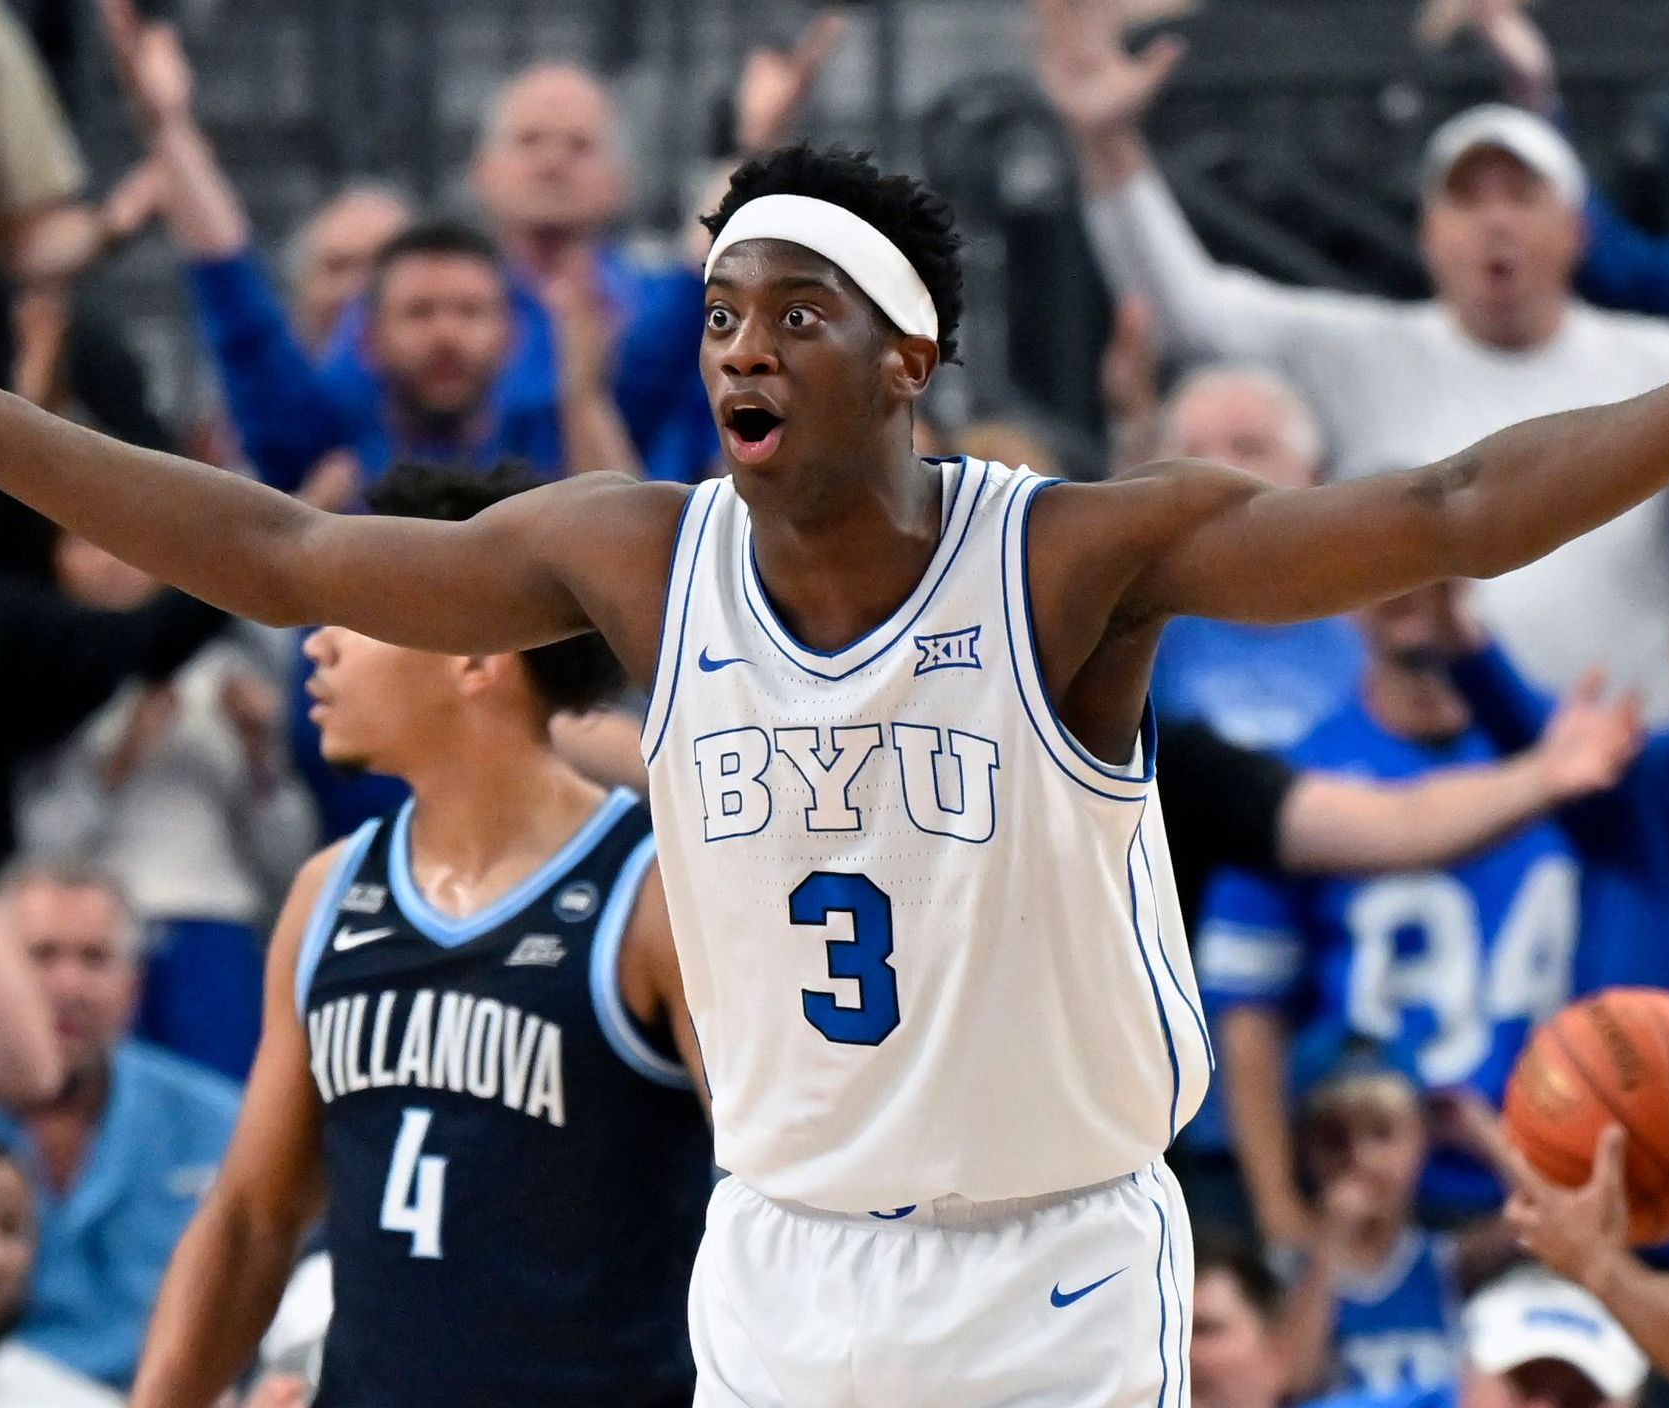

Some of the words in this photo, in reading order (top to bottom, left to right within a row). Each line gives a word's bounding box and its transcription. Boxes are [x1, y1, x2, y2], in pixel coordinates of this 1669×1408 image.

[694, 721, 1000, 844] BYU
[788, 870, 901, 1047] 3
[308, 989, 566, 1128] VILLANOVA
[380, 1106, 449, 1260] 4
